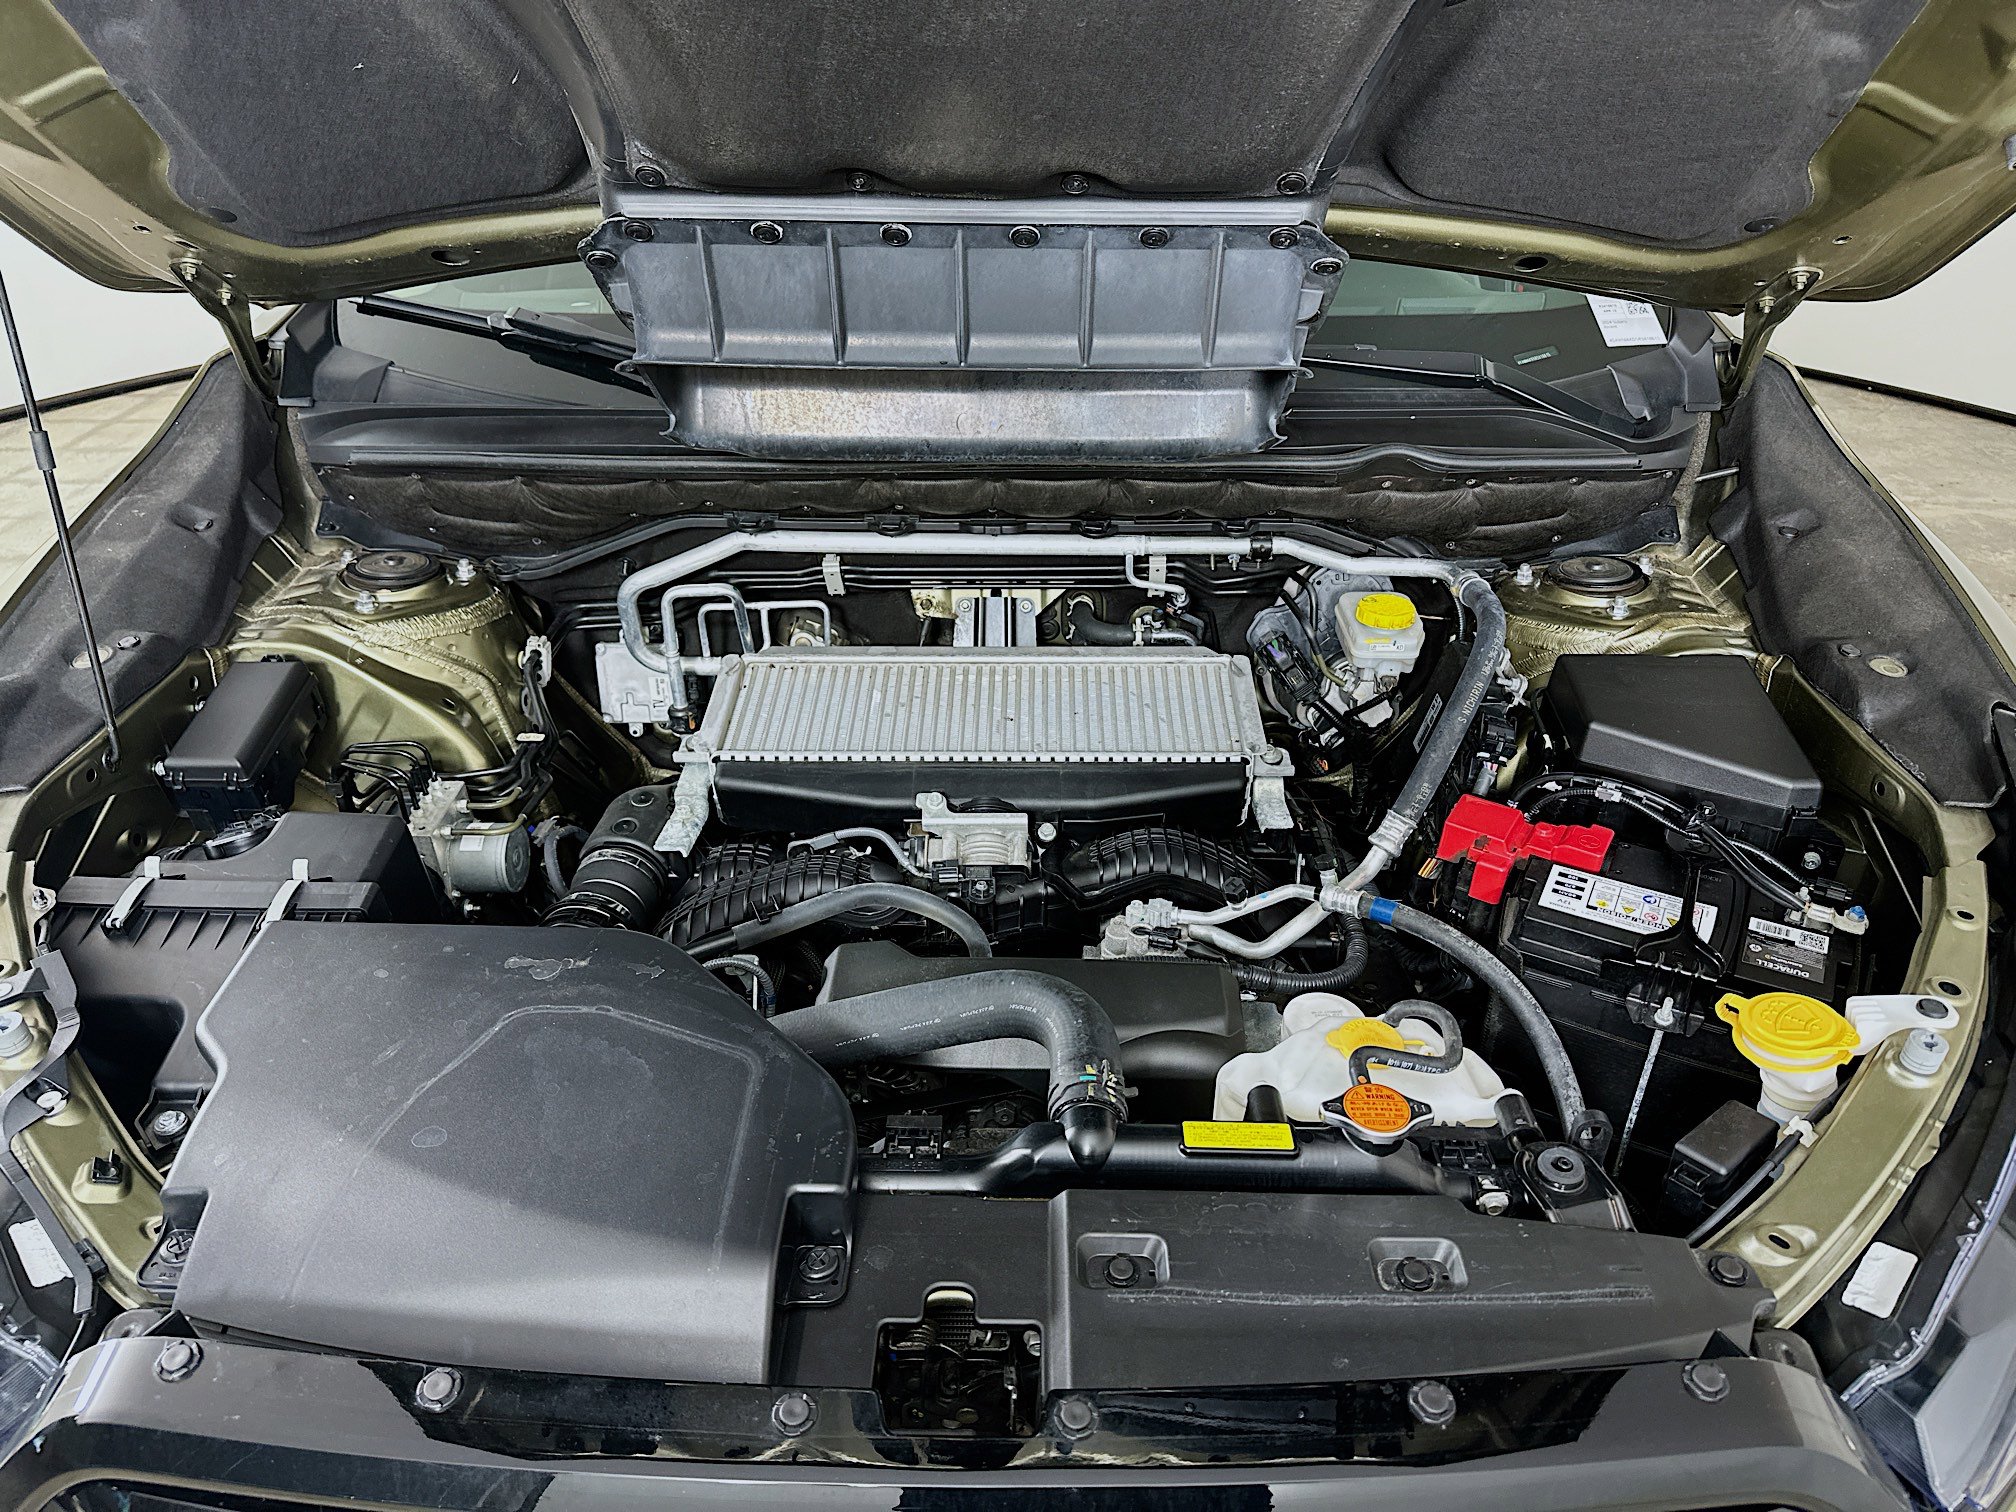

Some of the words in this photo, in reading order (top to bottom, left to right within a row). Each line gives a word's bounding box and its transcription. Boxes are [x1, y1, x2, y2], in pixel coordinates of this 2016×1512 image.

[1462, 681, 1485, 716] NICHIRIN
[1755, 958, 1810, 978] DURACELL
[1365, 1093, 1396, 1101] WARNING
